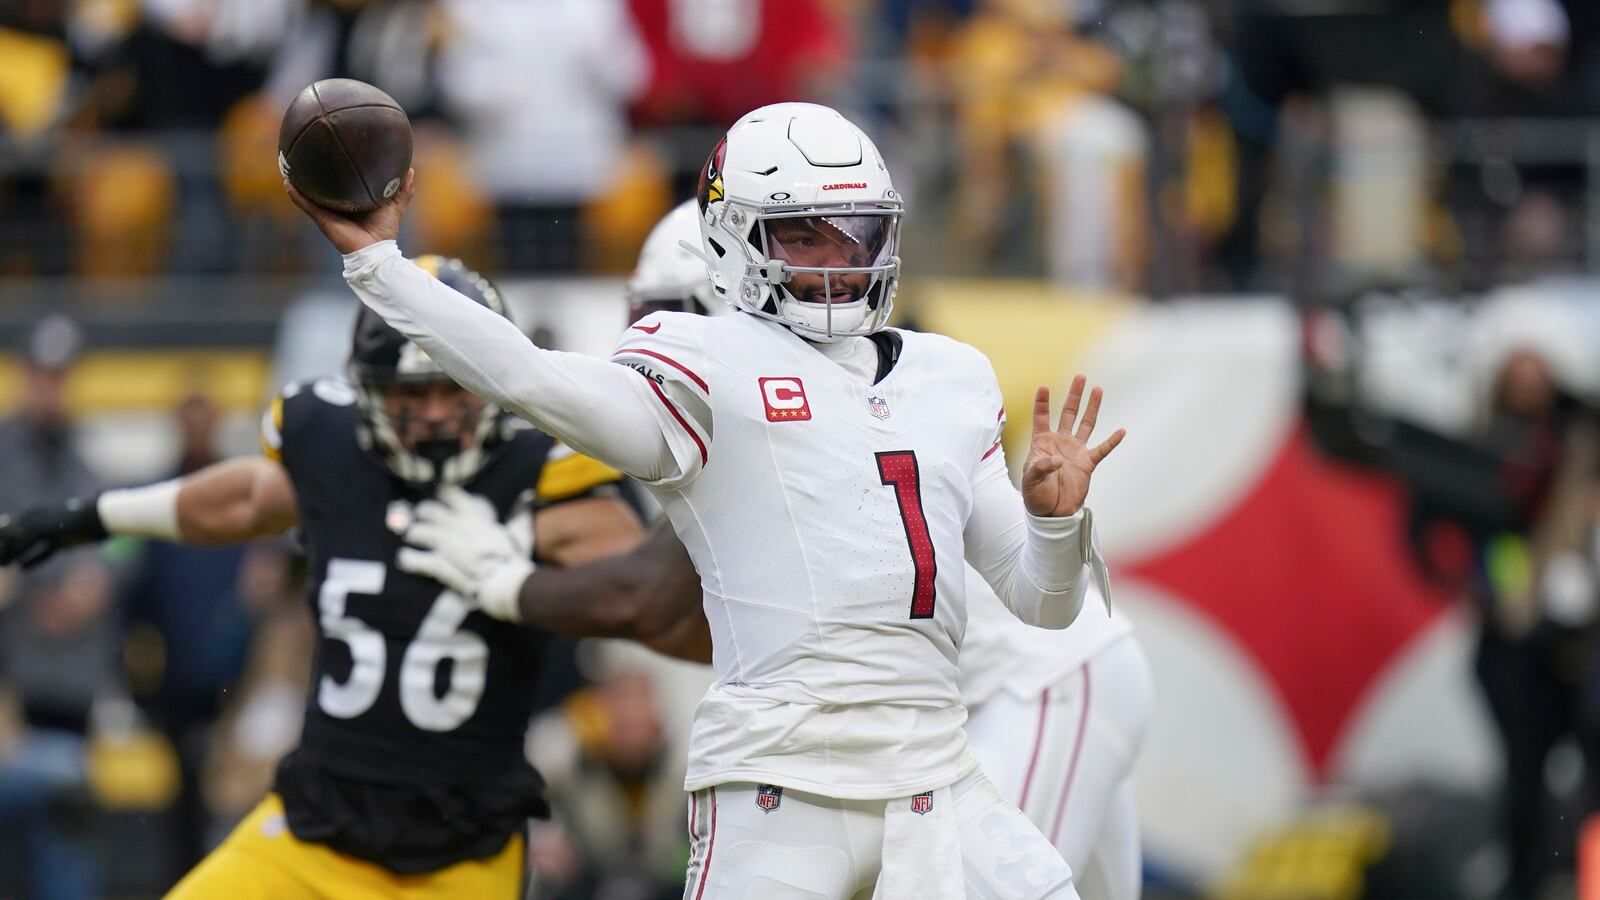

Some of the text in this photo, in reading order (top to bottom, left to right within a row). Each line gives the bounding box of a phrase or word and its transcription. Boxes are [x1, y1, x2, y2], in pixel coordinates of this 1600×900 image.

[822, 182, 868, 191] CARDINALS
[763, 379, 806, 410] C
[871, 403, 890, 416] NFL
[874, 450, 938, 620] 1
[318, 557, 490, 733] 56
[759, 794, 778, 808] NFL
[913, 796, 931, 811] NFL
